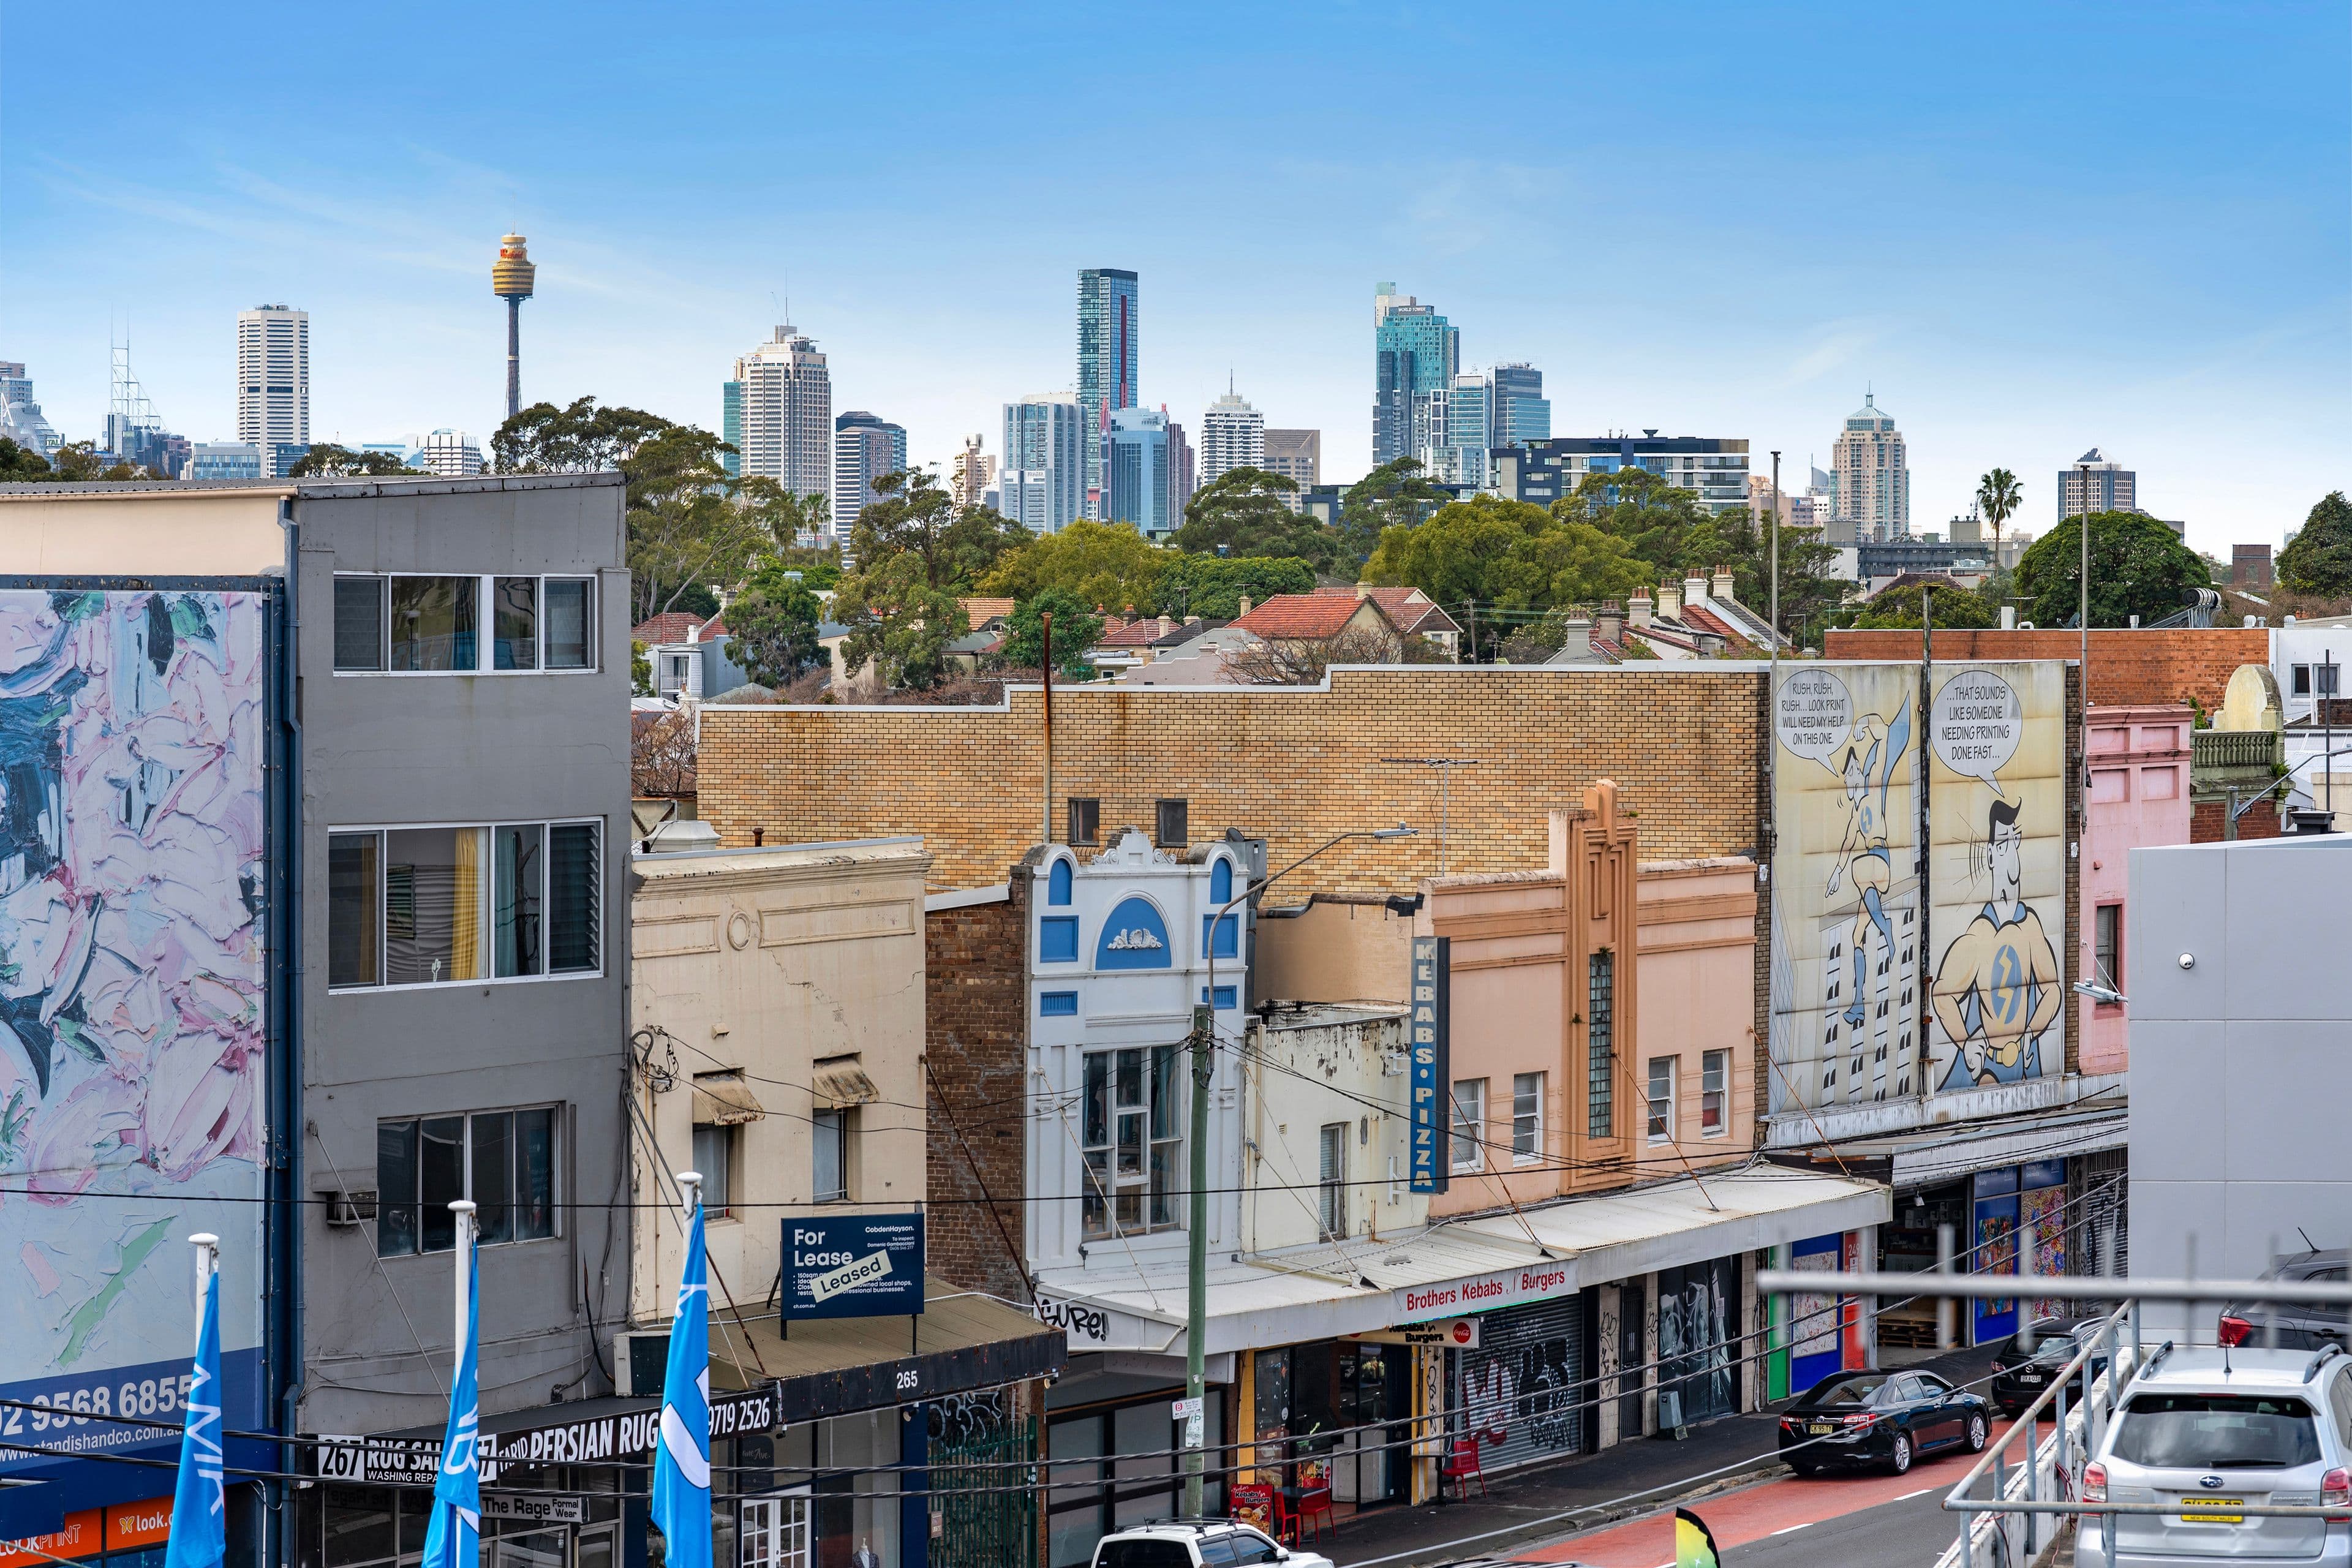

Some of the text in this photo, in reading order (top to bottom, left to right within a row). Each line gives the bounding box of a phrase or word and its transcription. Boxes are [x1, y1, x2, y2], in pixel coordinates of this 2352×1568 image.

[1792, 682, 1833, 696] RUSH, RUSH,
[1974, 686, 2006, 700] SOUNDS
[1809, 699, 1825, 710] LOOK
[1826, 699, 1845, 710] PRINT
[1949, 706, 2002, 720] LIKE SOMEONE
[1782, 715, 1844, 728] WILL NEED MY HELP
[1793, 733, 1834, 745] ON THIS ONE.
[1942, 725, 2010, 741] NEEDING PRINTING
[1951, 745, 1972, 760] DONE
[1415, 944, 1435, 1065] KEBABS
[1413, 1087, 1433, 1187] PIZZA
[794, 1229, 826, 1246] For
[794, 1250, 853, 1267] Lease
[820, 1257, 881, 1294] Leased
[1407, 1289, 1457, 1311] Brothers
[1462, 1278, 1502, 1301] Kebabs
[1521, 1270, 1565, 1292] Burgers
[1405, 1332, 1444, 1344] Burgers
[897, 1370, 918, 1390] 265
[0, 1398, 23, 1436] 2
[31, 1386, 111, 1431] 9568
[708, 1397, 770, 1436] 9719 2526
[529, 1419, 614, 1470] PERSIAN
[619, 1411, 659, 1455] RUG
[322, 1438, 361, 1477] 267
[368, 1439, 406, 1469] RUG
[368, 1470, 413, 1482] WASHING
[481, 1497, 551, 1519] The Rage
[552, 1498, 579, 1509] Formal
[555, 1510, 577, 1518] Wear
